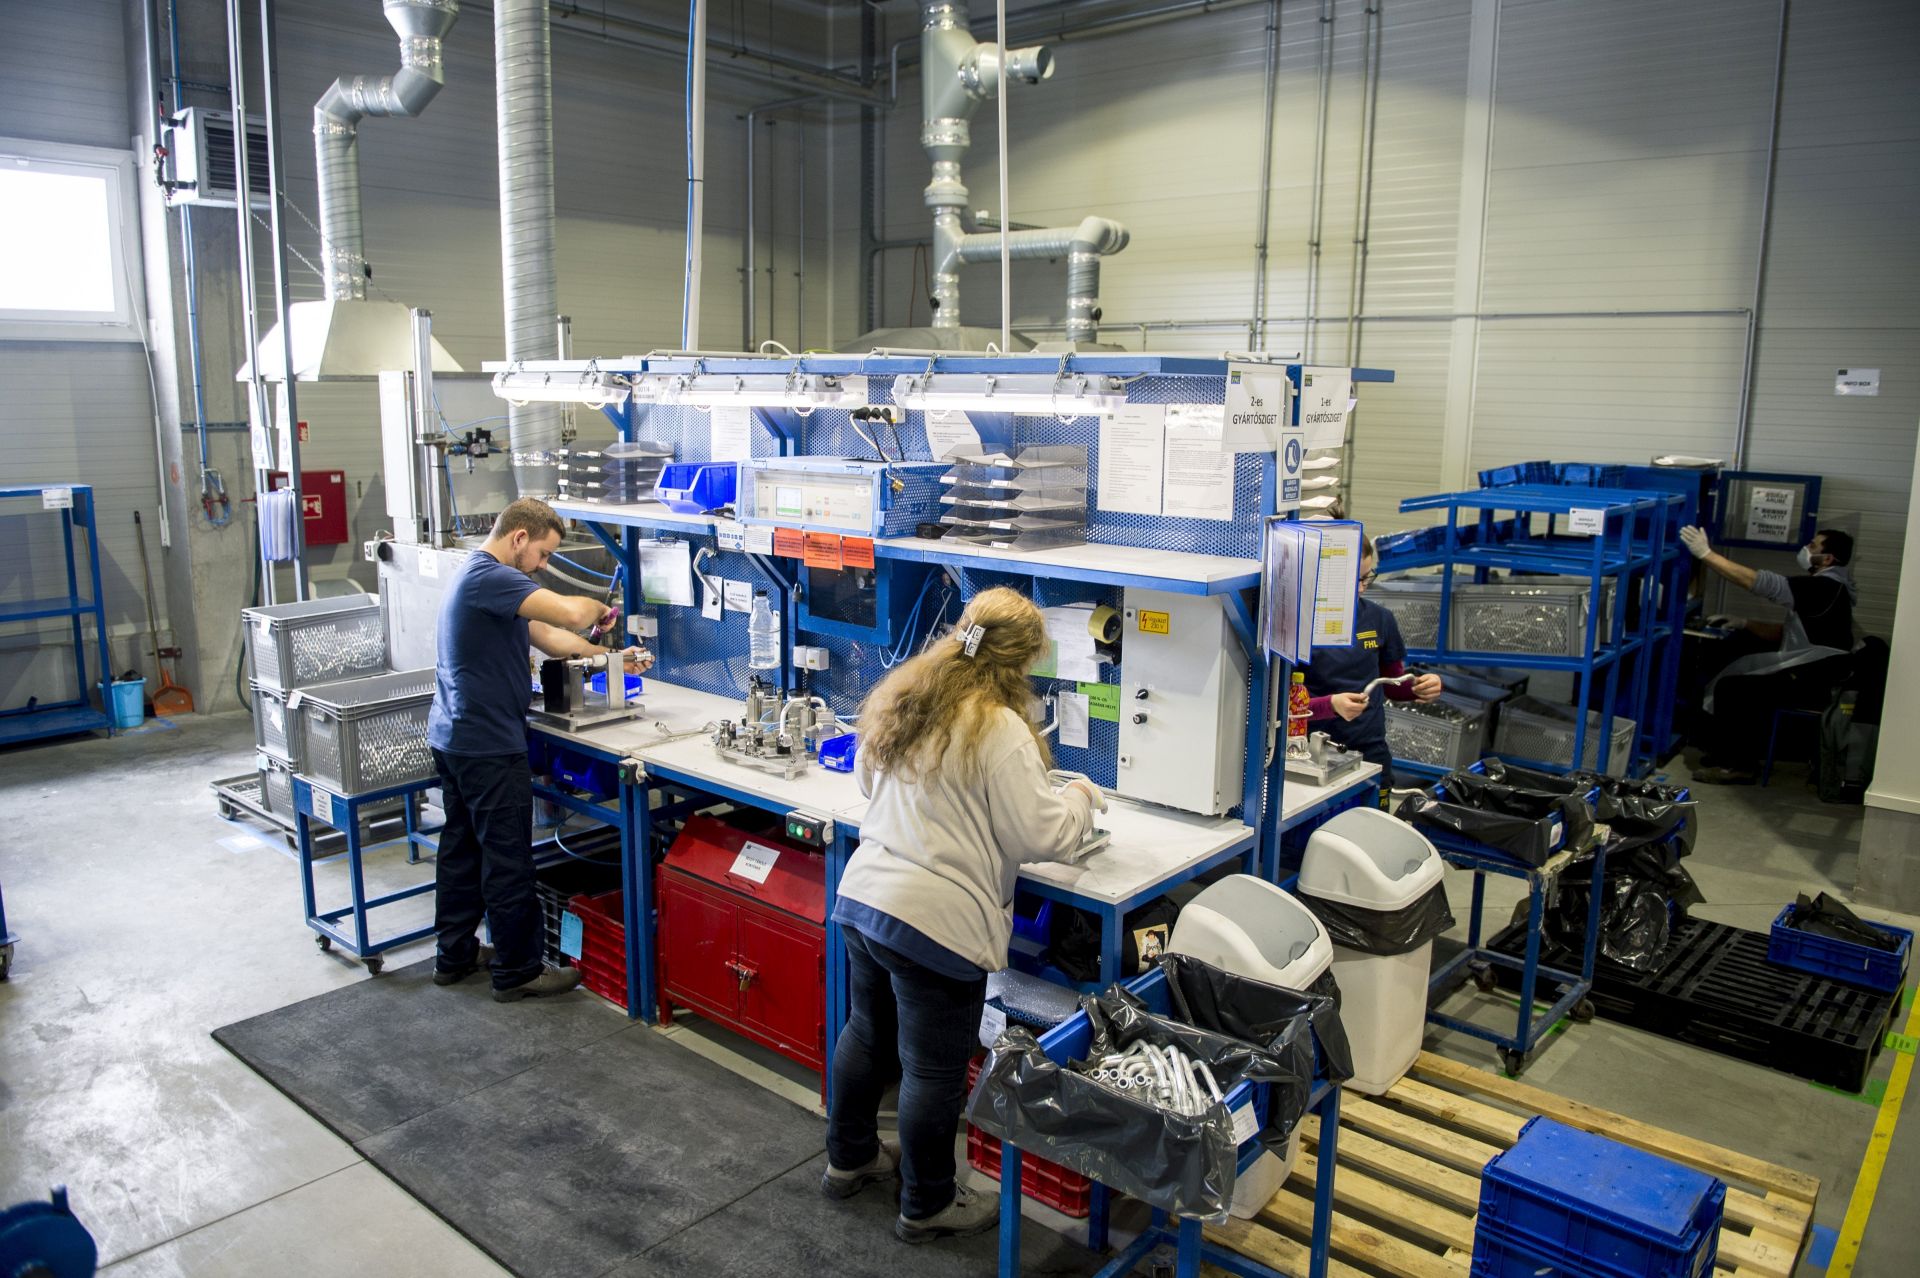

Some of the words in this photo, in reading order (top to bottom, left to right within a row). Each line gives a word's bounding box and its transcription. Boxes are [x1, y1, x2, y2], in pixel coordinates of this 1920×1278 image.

[1250, 396, 1263, 407] 2-es
[1321, 397, 1331, 407] 1-es
[1232, 412, 1277, 425] GYÁRTÓSZIGET
[1306, 412, 1342, 424] GYÁRTÓSZIGET
[1364, 640, 1379, 649] FHL
